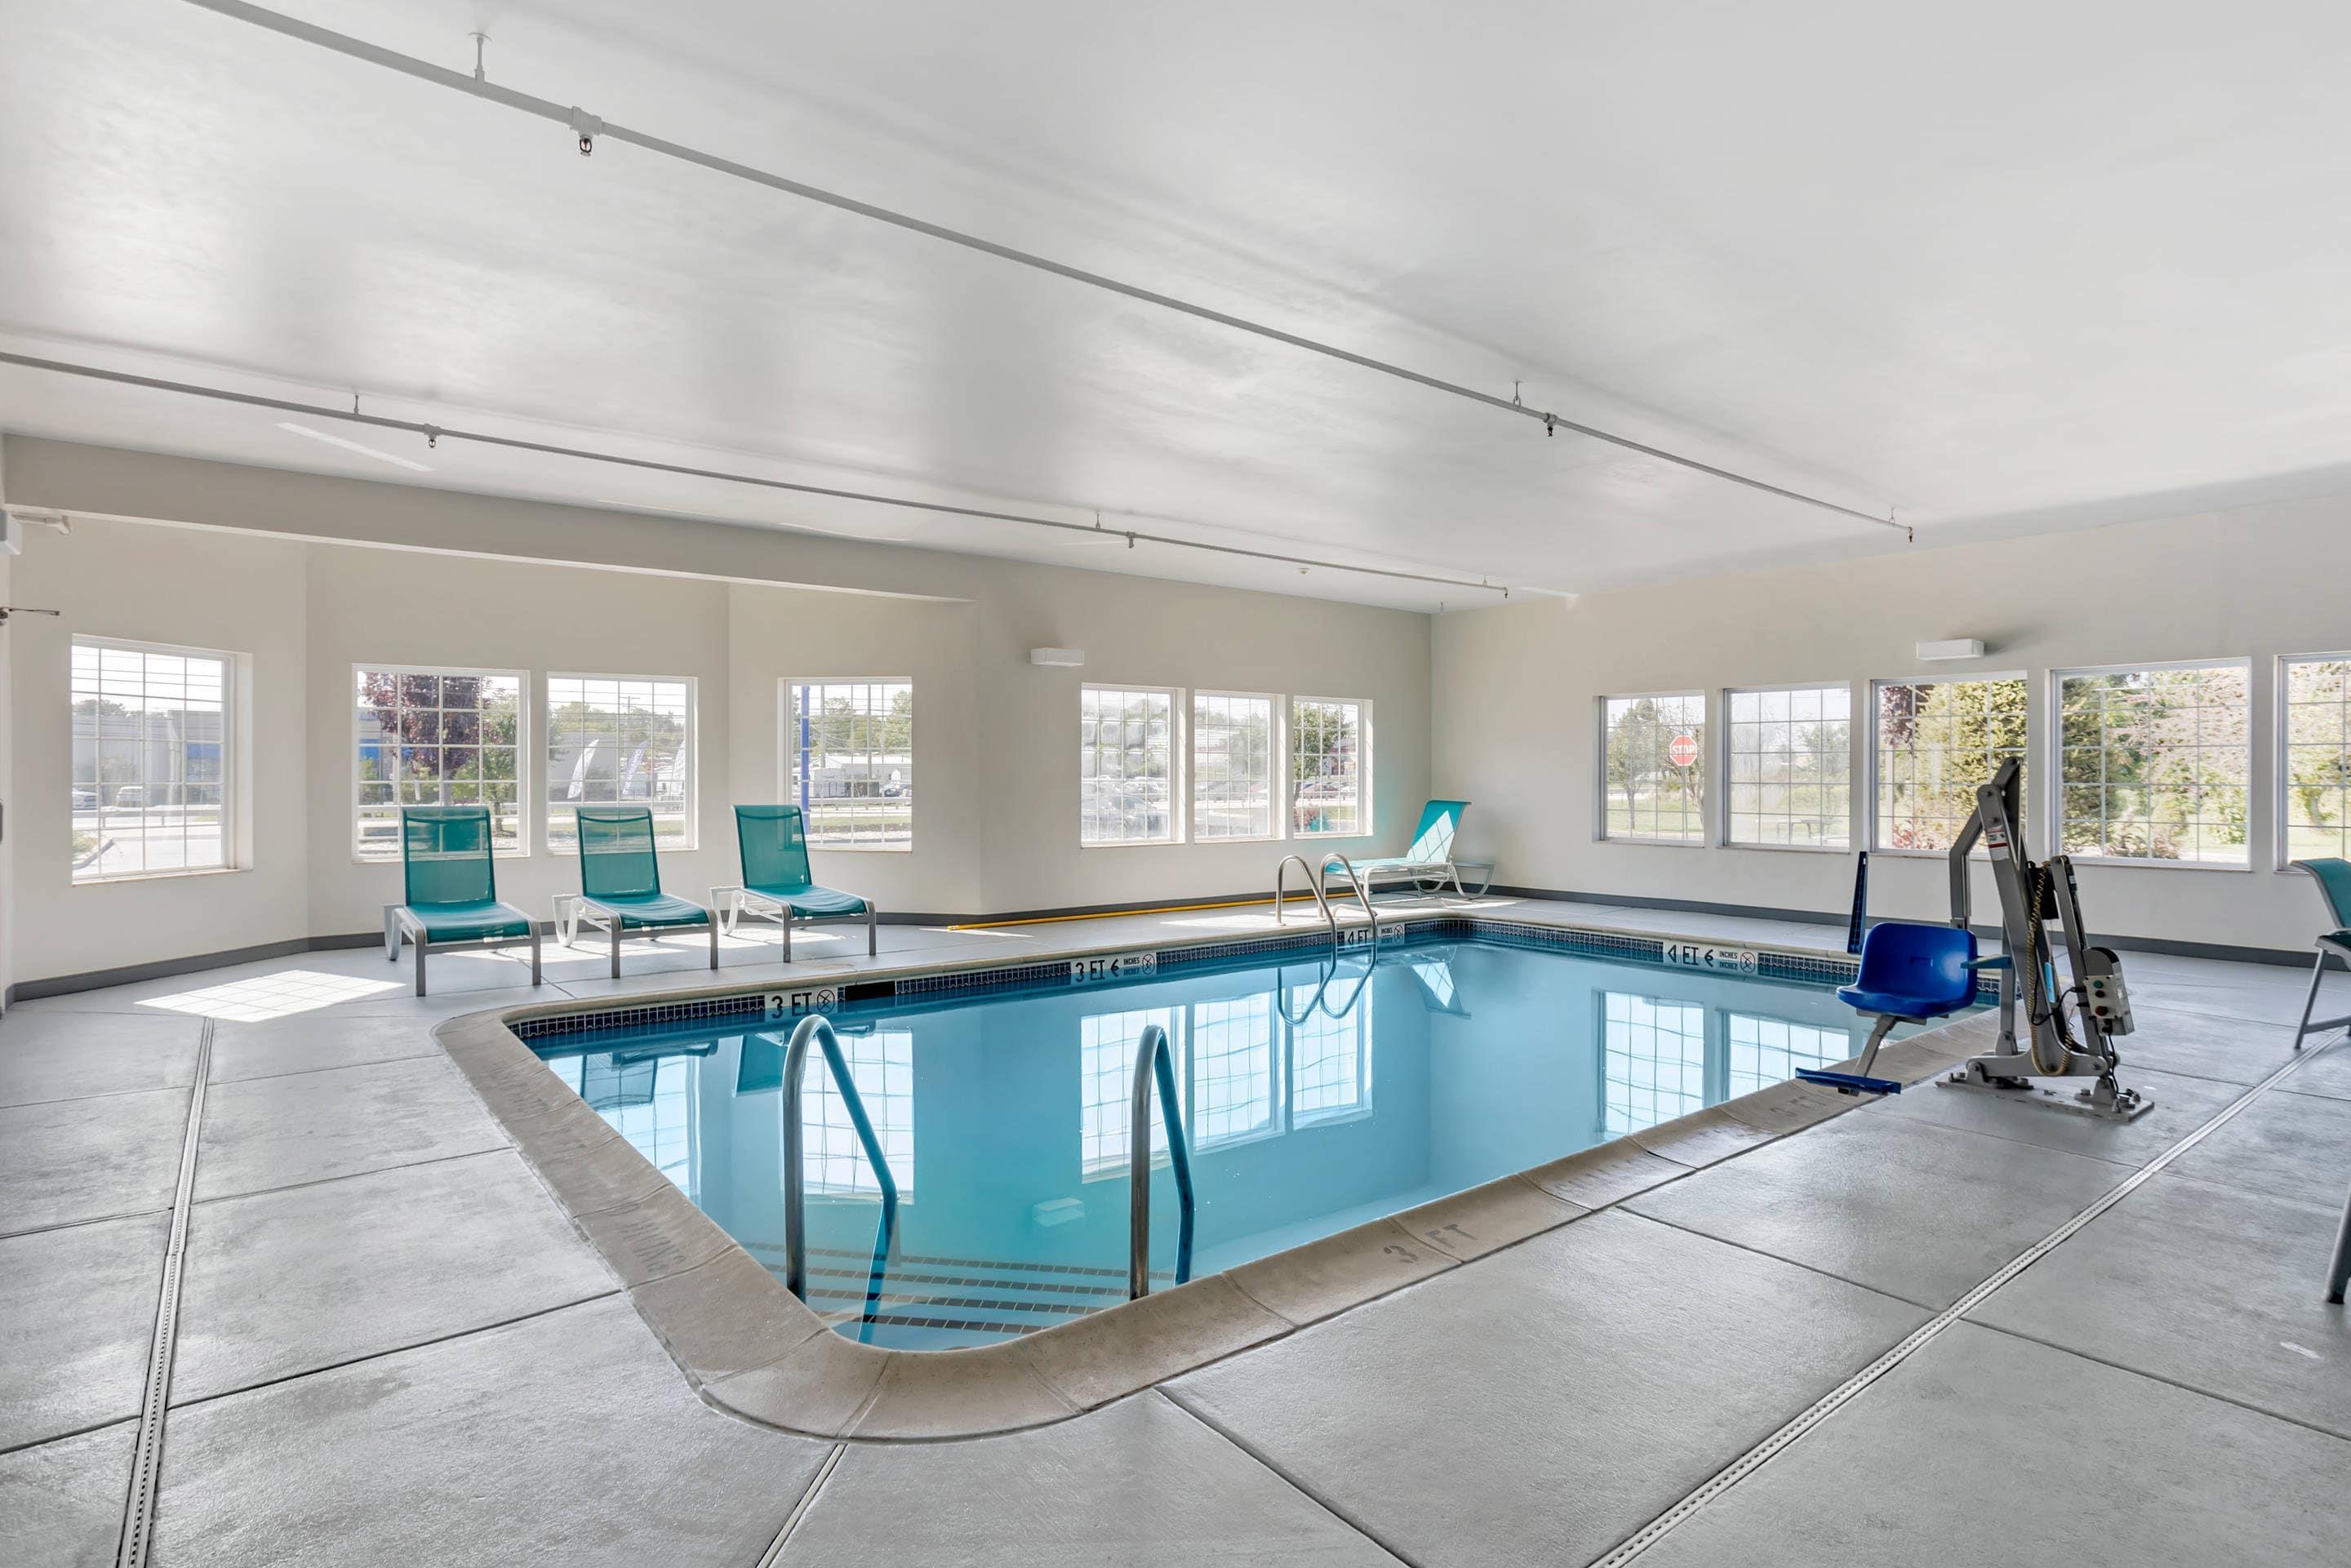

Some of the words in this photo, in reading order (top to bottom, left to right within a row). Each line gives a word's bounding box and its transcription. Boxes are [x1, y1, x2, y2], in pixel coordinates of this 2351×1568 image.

[1672, 744, 1695, 757] STOP
[1719, 950, 1738, 960] INCHES
[1123, 957, 1140, 966] INCHES
[1383, 1240, 1420, 1264] 3
[1424, 1223, 1479, 1249] FT
